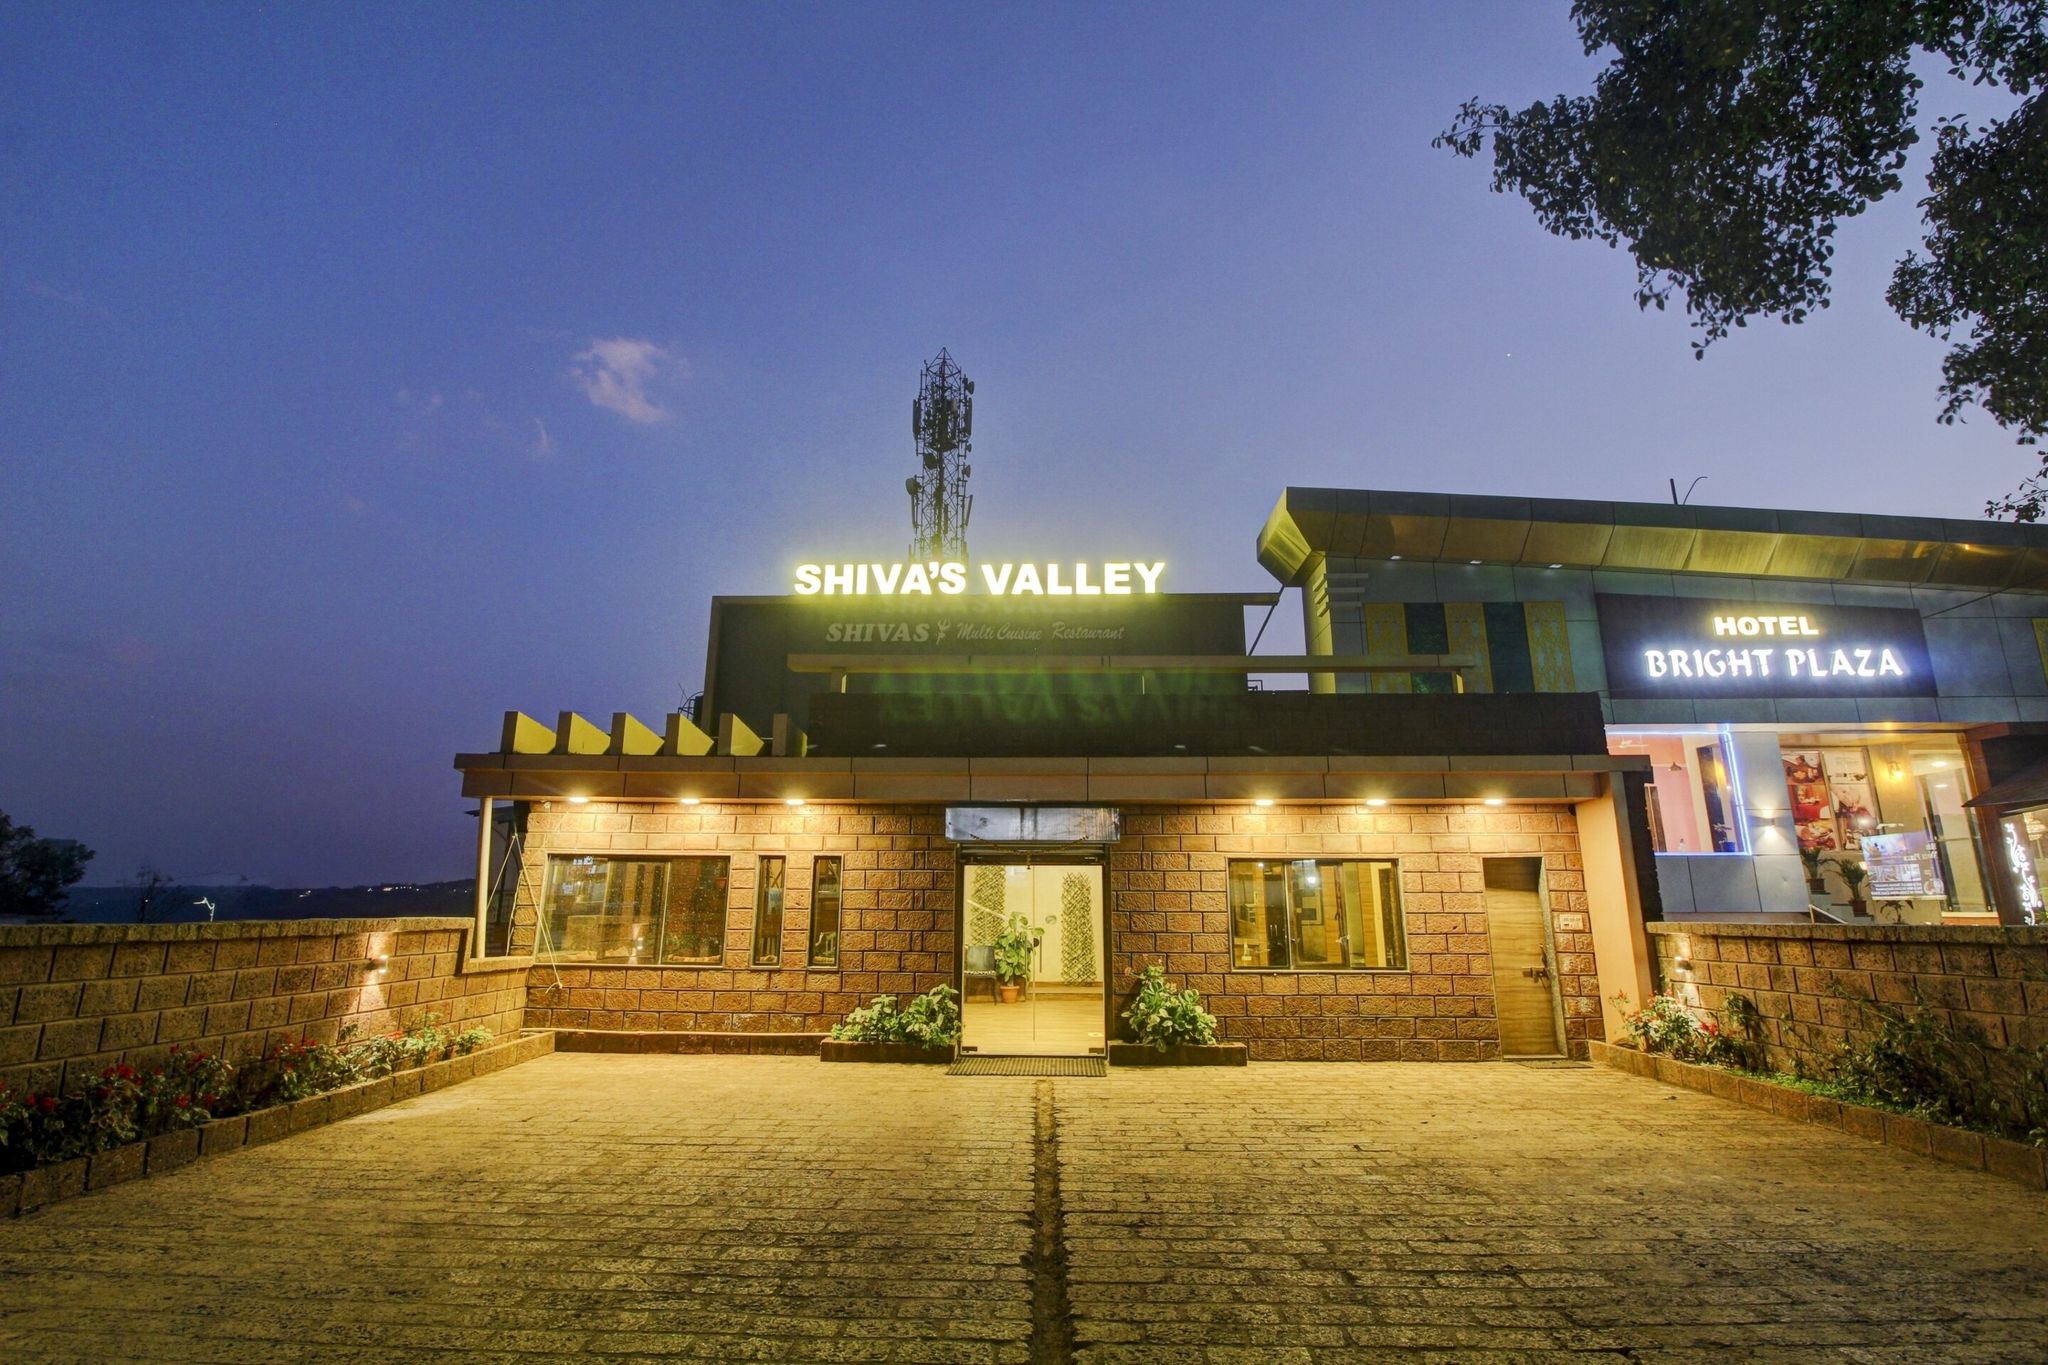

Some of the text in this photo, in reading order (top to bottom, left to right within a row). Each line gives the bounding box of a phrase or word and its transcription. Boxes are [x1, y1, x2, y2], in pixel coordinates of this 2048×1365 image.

[794, 561, 1166, 596] SHIVA'S VALLEY
[826, 620, 1126, 642] SHIVAS Multi Cuisine Restaurant
[1713, 616, 1820, 636] HOTEL
[1645, 647, 1904, 678] BRIGHT PLAZA
